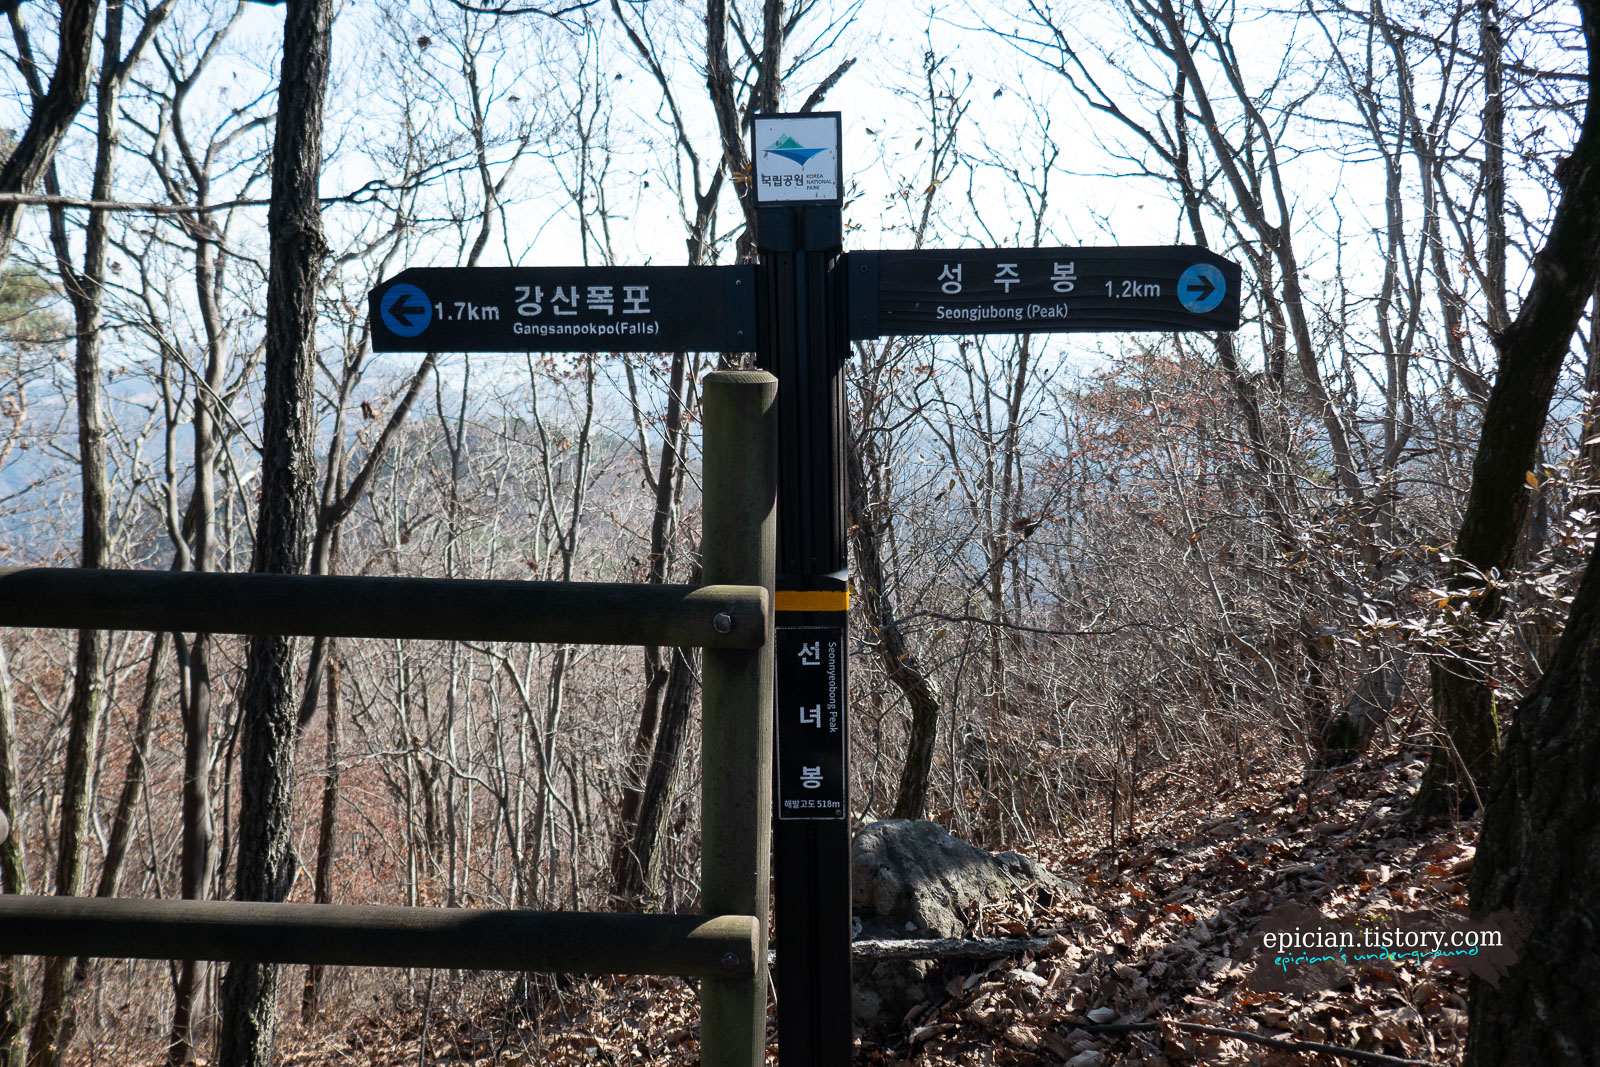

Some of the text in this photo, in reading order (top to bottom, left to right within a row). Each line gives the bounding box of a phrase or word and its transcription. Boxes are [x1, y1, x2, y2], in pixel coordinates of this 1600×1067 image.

[1104, 280, 1161, 299] 1.2km
[513, 285, 652, 316] 강산폭포
[434, 301, 500, 322] 1.7km
[936, 303, 1069, 321] Seongjubong (Peak)
[513, 321, 660, 337] Gangsanpokpo(Falls)
[826, 641, 839, 733] Seonnyeobong Peak
[784, 799, 841, 809] 해발고도 518m
